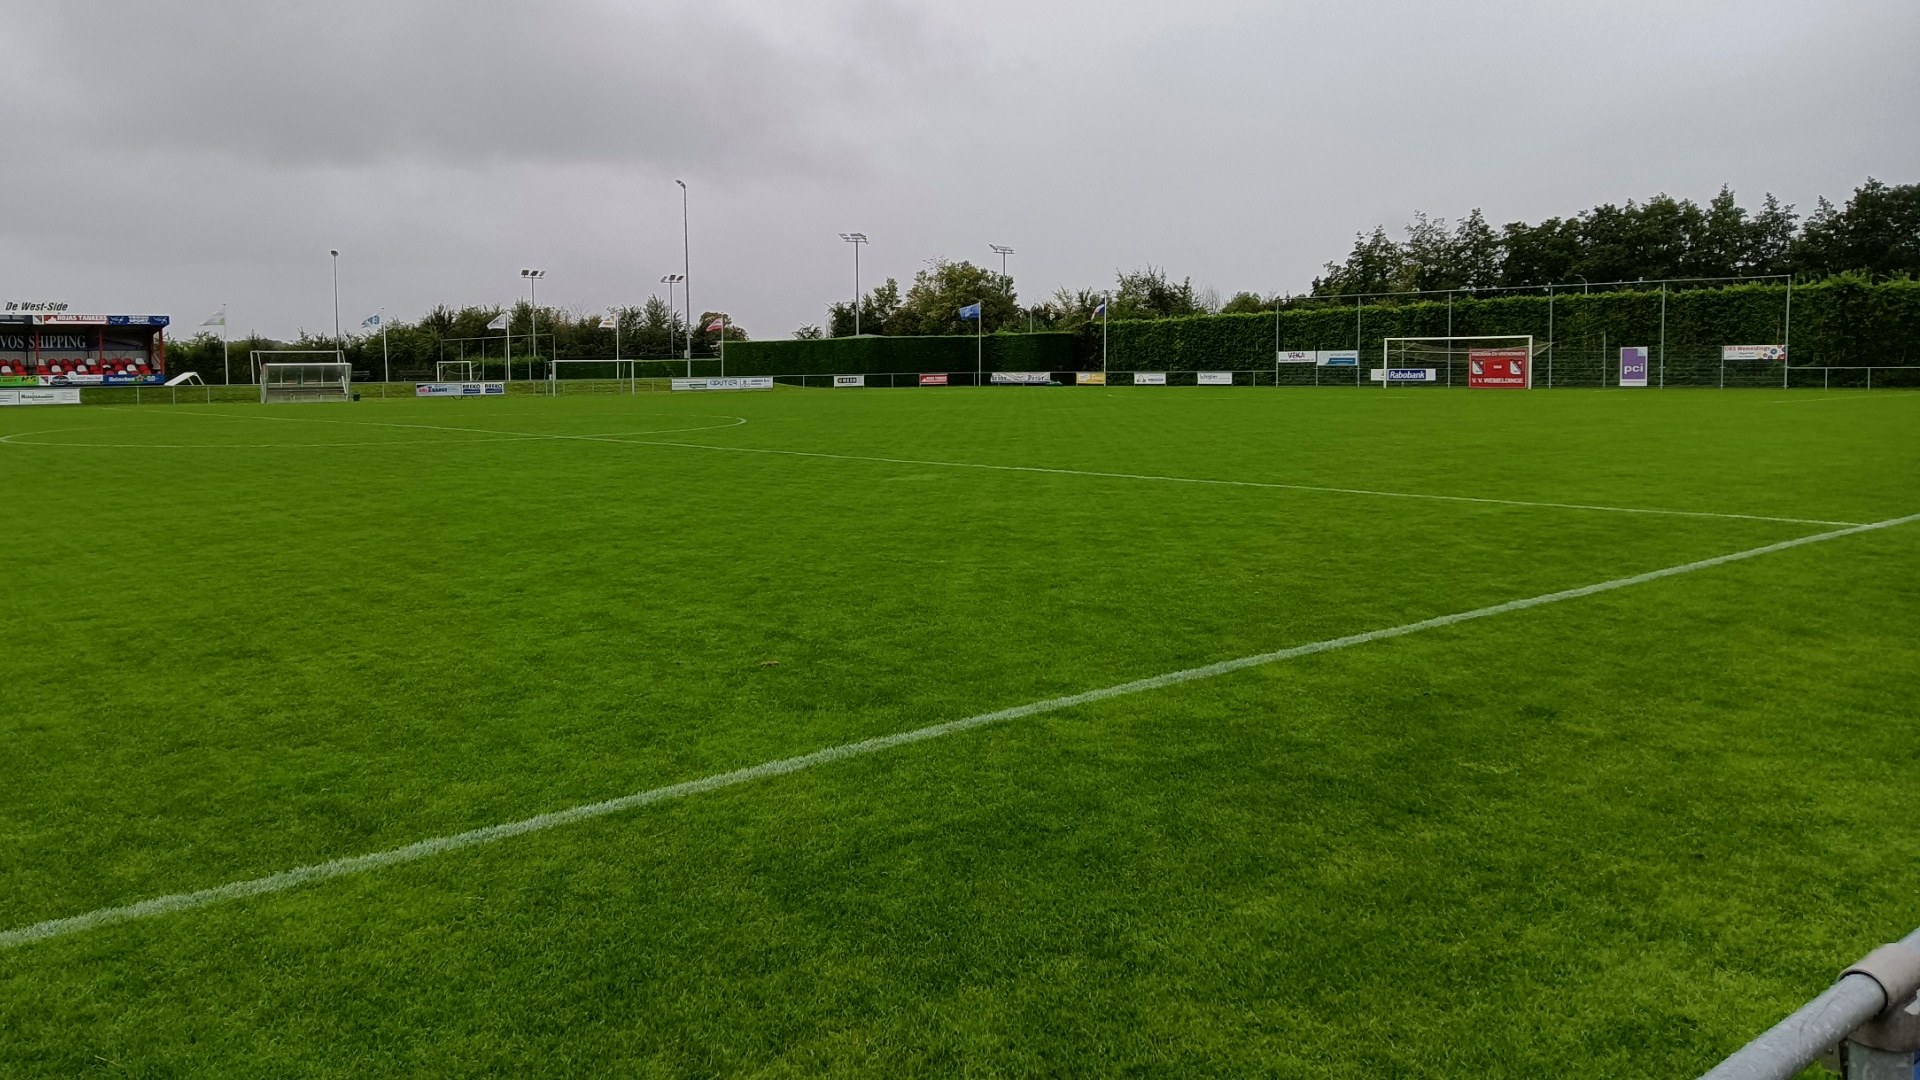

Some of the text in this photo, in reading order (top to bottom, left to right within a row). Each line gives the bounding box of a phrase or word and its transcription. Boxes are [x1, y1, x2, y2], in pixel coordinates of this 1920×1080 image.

[5, 302, 68, 311] De West-Side
[0, 335, 86, 348] VOS SHIPPING
[1623, 363, 1644, 375] pci
[1390, 370, 1425, 379] Rabobank
